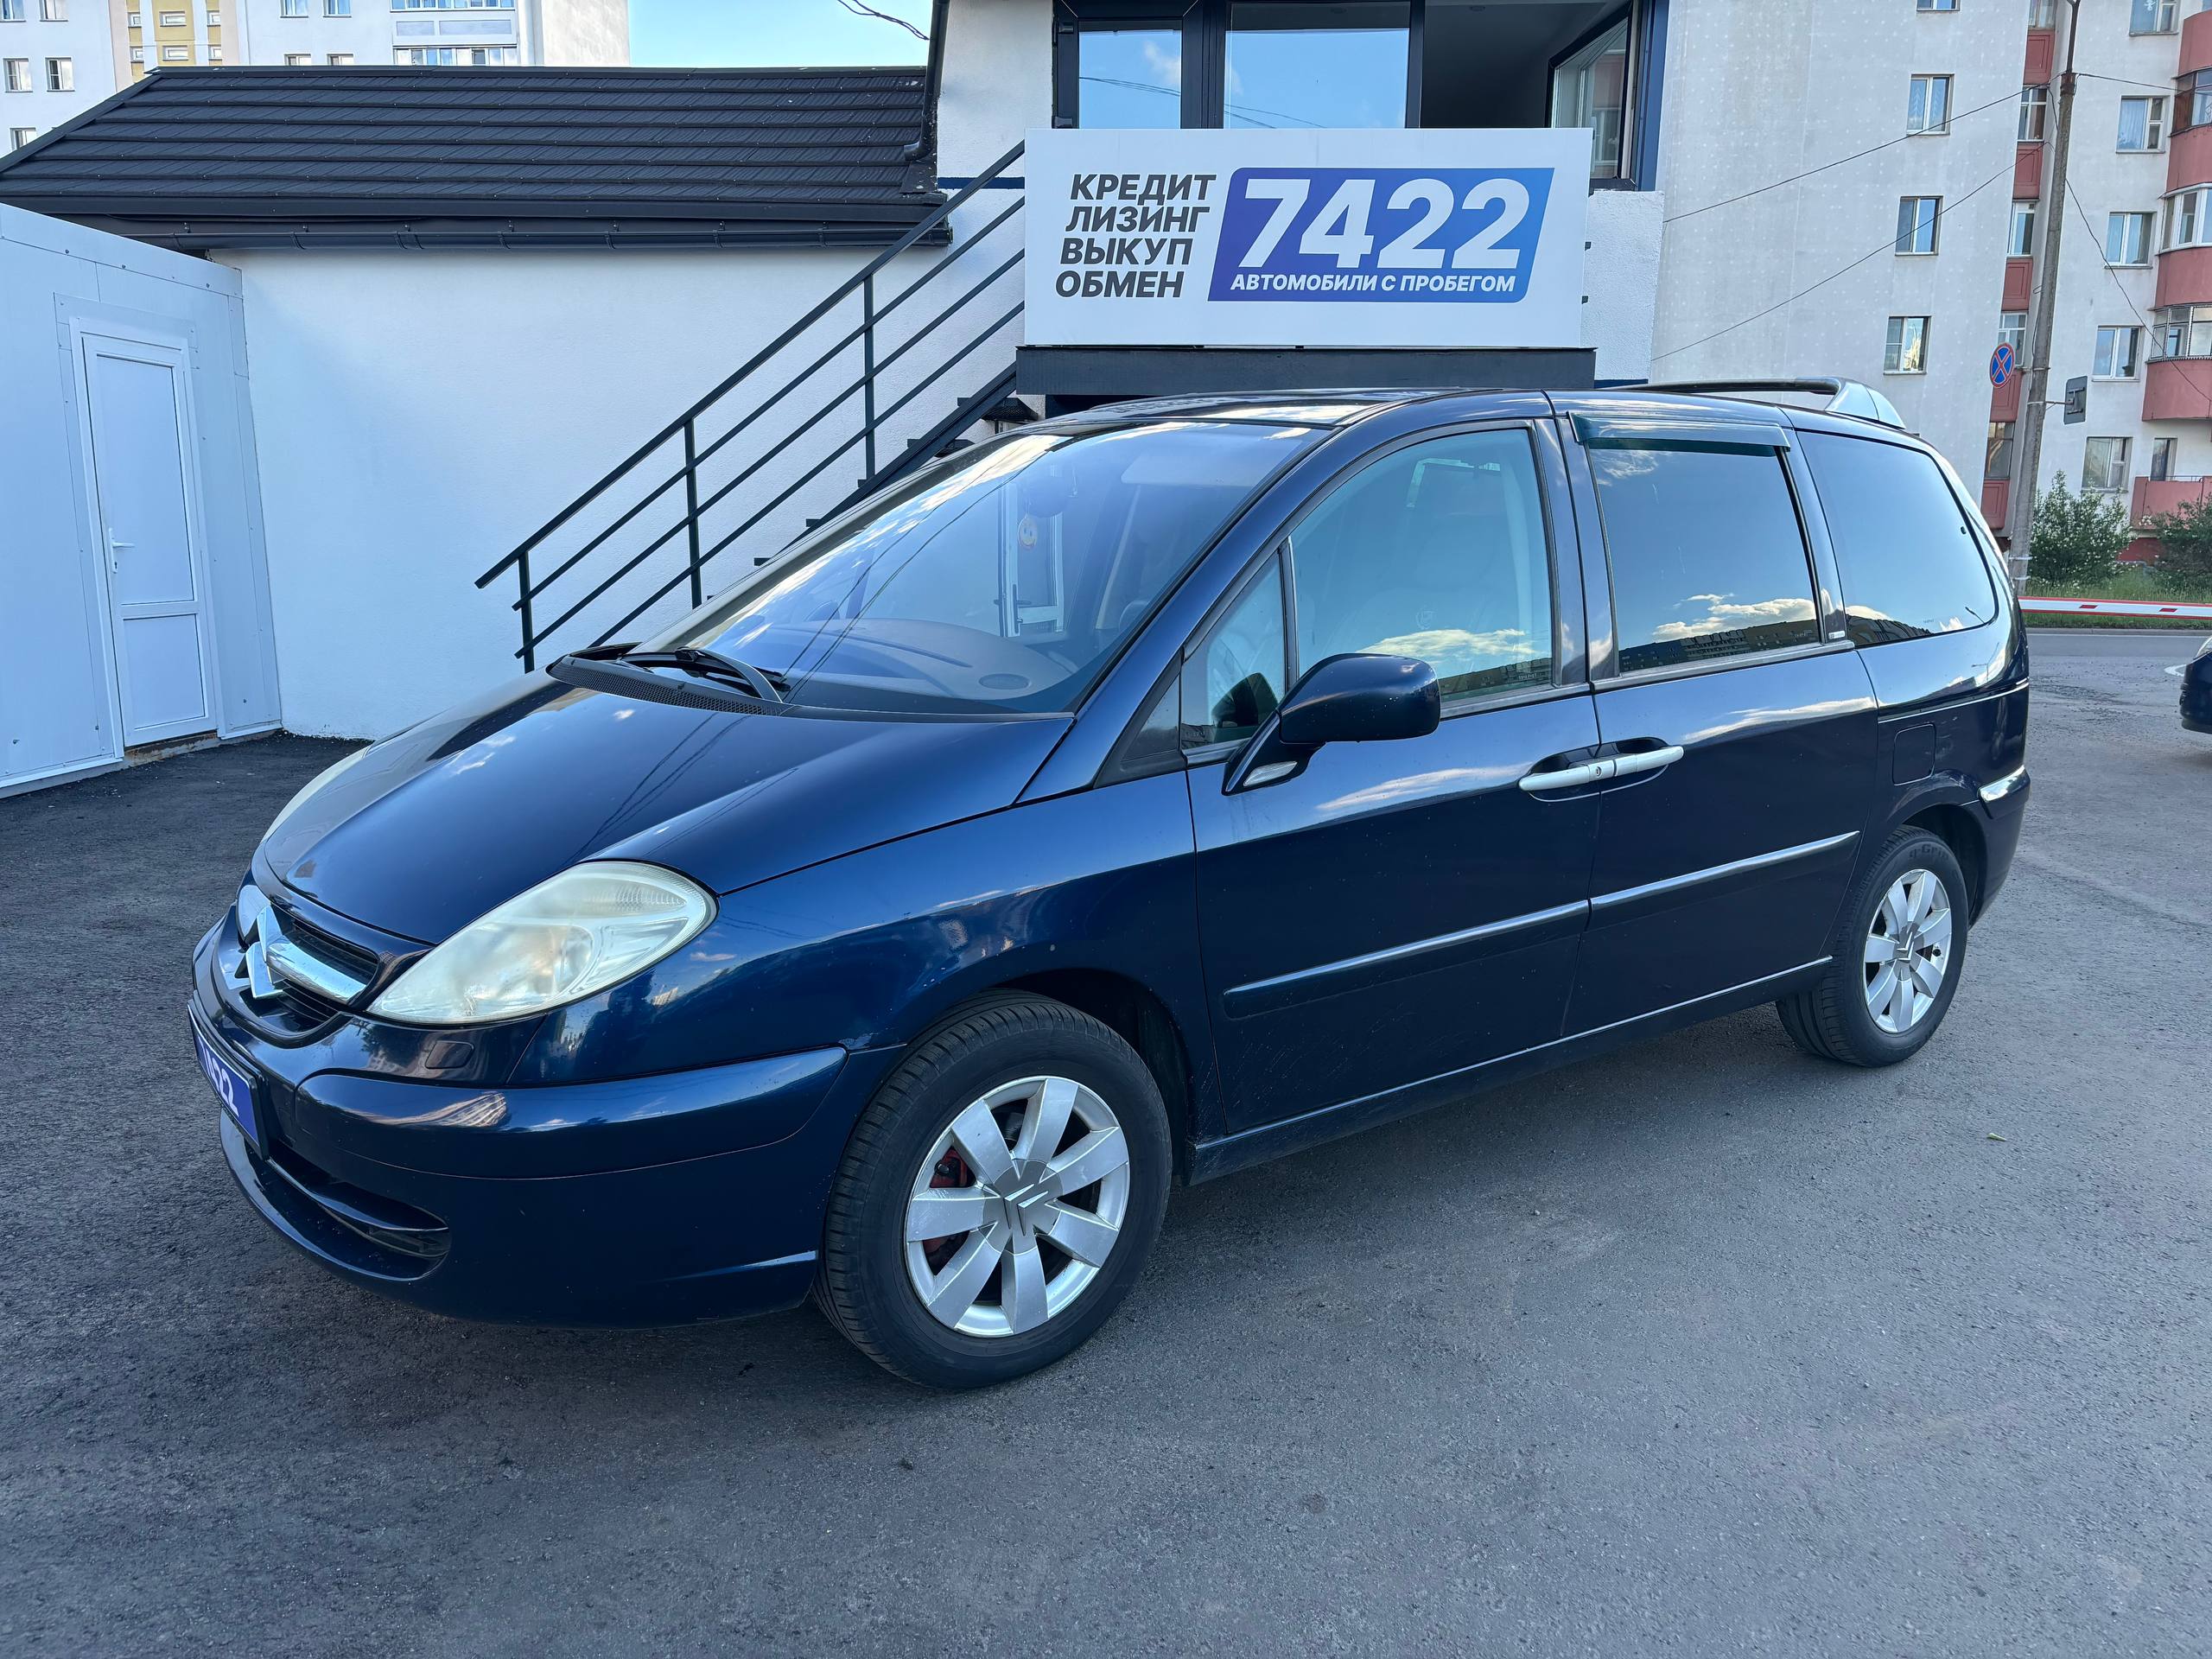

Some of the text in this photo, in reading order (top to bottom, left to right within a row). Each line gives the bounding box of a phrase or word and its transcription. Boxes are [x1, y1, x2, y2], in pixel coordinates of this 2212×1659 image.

[1070, 174, 1217, 206] КРЕДИТ
[1065, 206, 1211, 232] ЛИЗИНГ
[1238, 178, 1529, 269] 7422
[1060, 238, 1193, 265] ВЫКУП
[1055, 270, 1185, 298] ОБМЕН
[1230, 273, 1516, 293] АВТОМОБИЛИ С ПРОБЕГОМ
